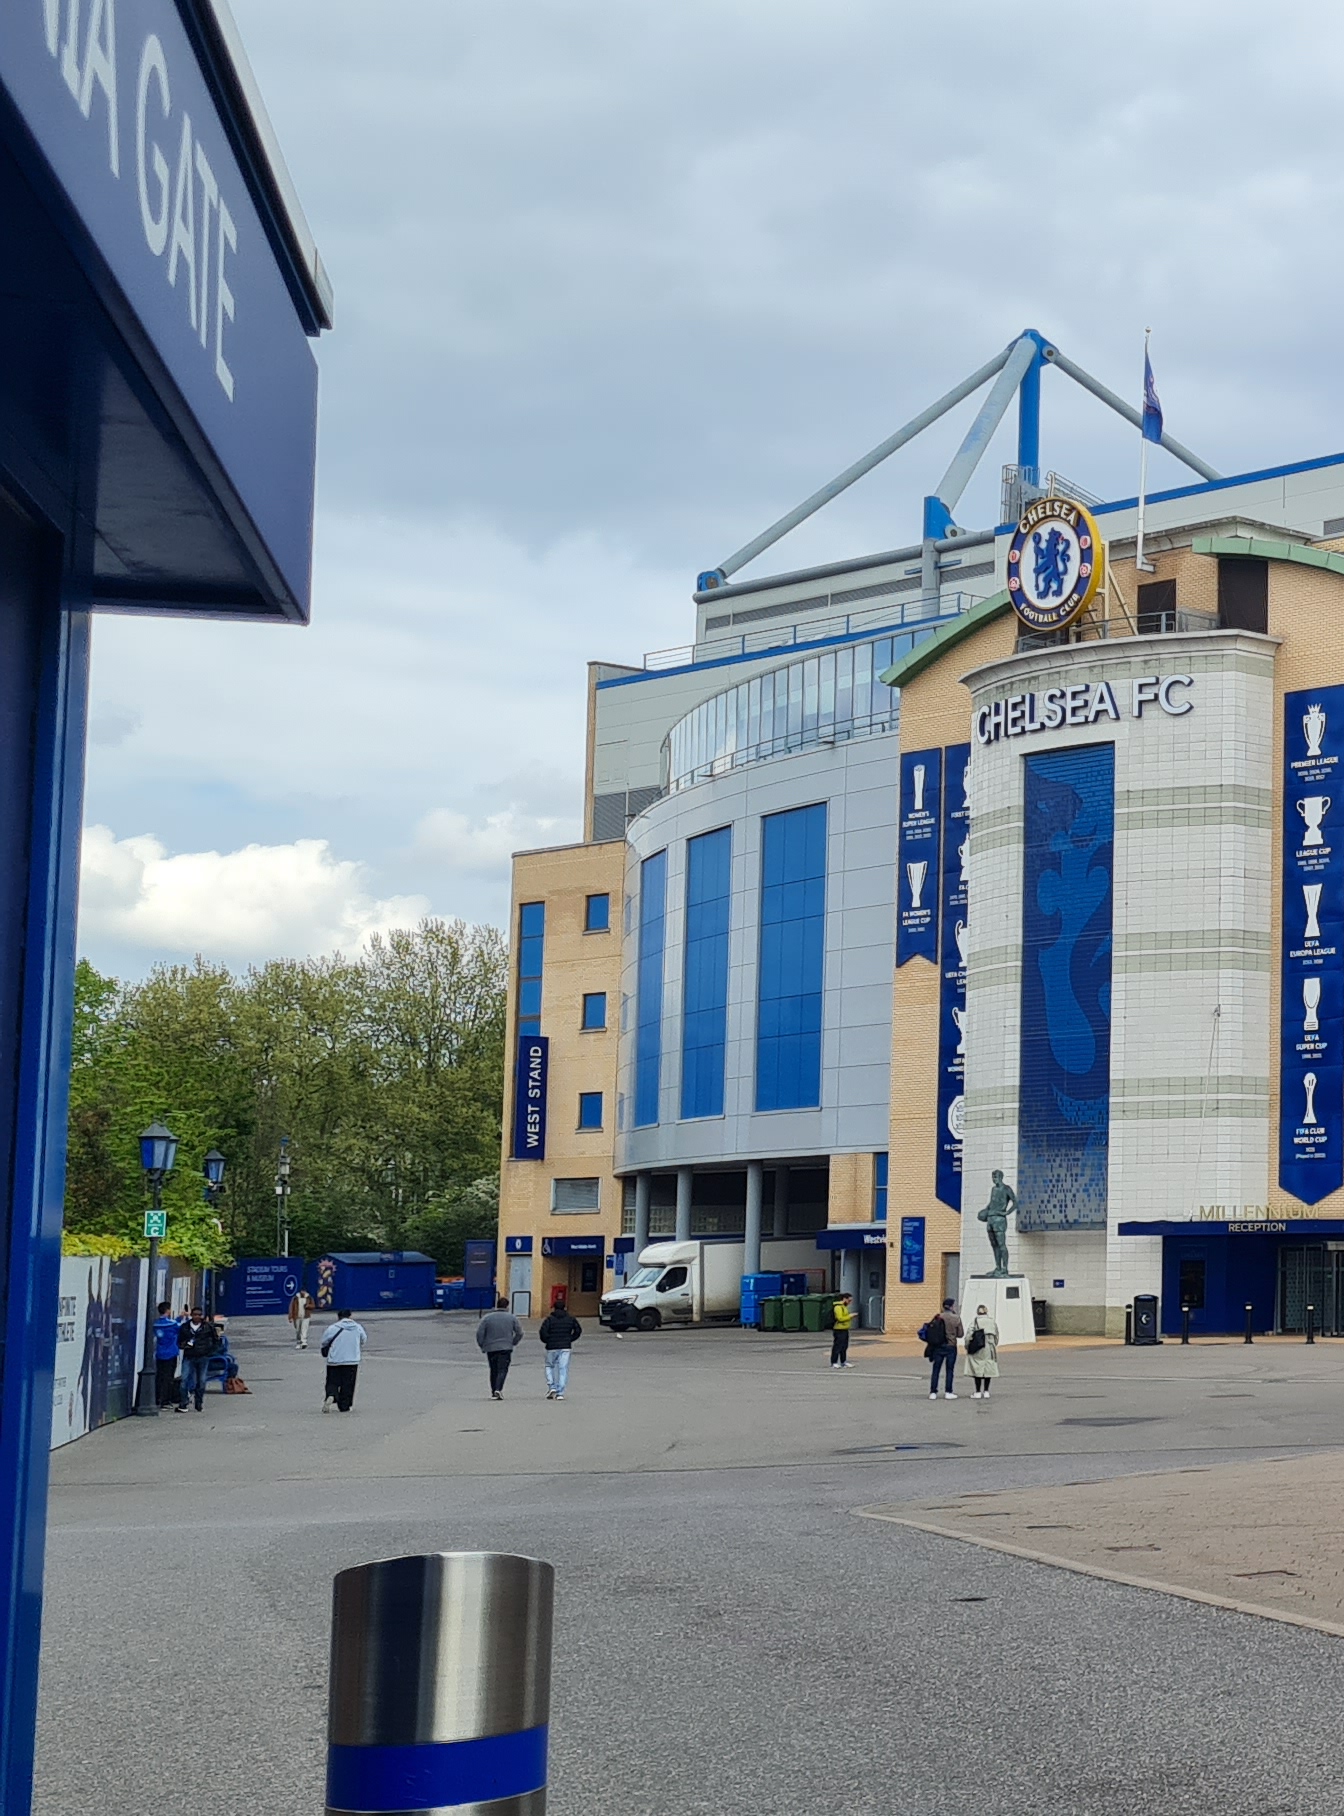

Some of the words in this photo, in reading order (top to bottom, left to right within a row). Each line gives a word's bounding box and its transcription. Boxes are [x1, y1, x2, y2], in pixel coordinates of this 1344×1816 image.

[135, 33, 238, 403] GATE
[1019, 501, 1078, 534] CHELSEA
[1019, 602, 1059, 623] FOOTBALL
[1060, 592, 1081, 616] CLUB
[976, 681, 1121, 745] CHELSEA
[1131, 674, 1194, 718] FC
[528, 1046, 542, 1098] STAND
[526, 1104, 541, 1148] WEST
[1199, 1204, 1320, 1221] MILLENNIUM
[1228, 1222, 1287, 1232] RECEPTION
